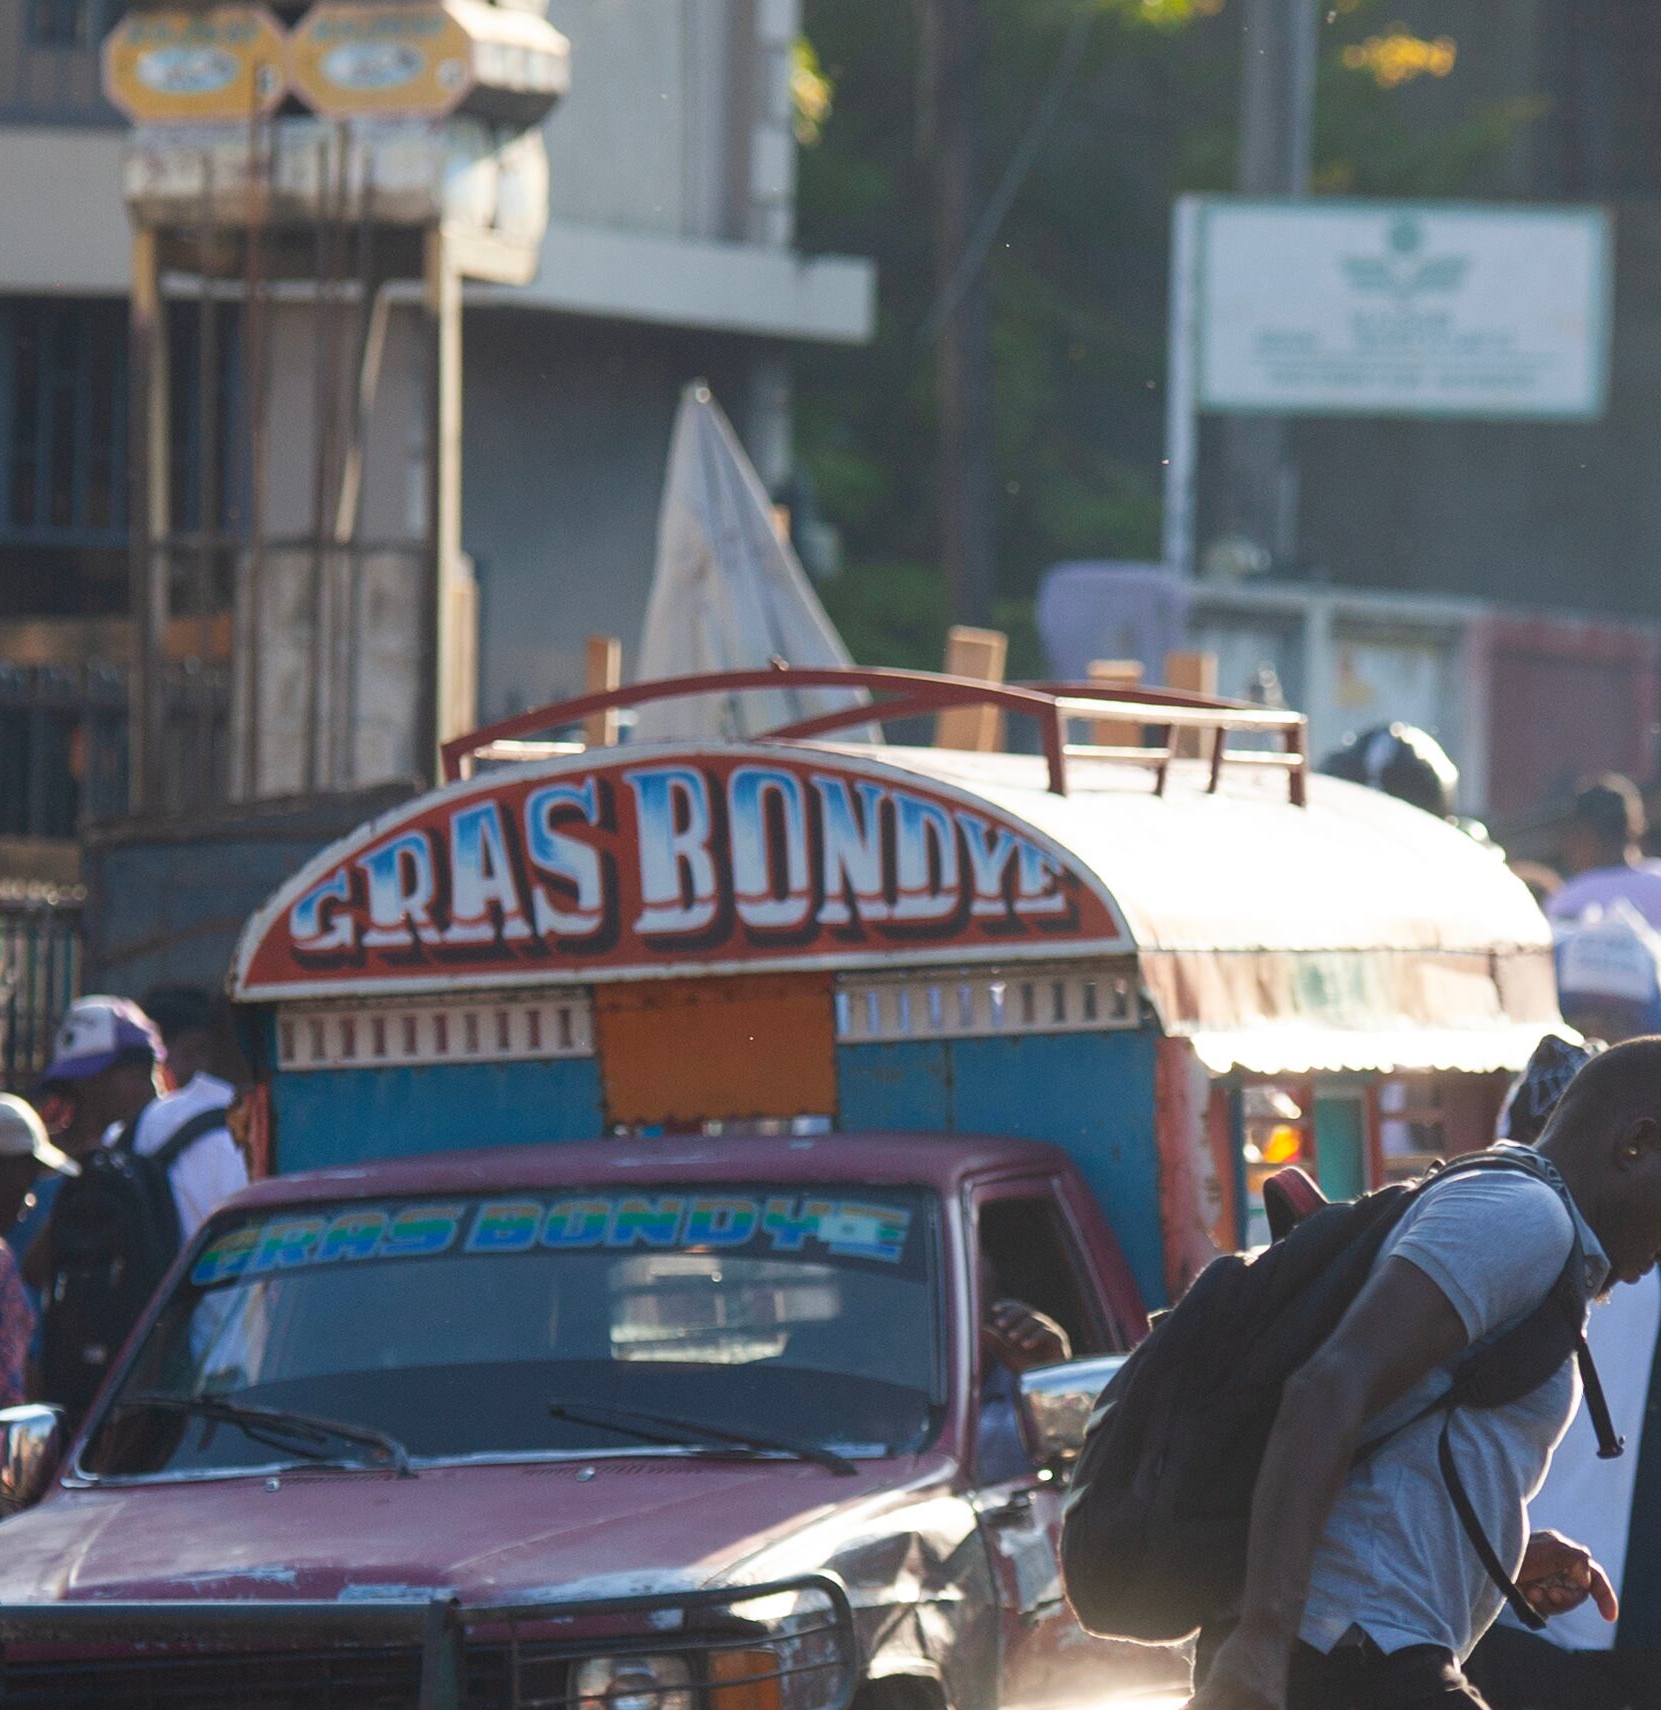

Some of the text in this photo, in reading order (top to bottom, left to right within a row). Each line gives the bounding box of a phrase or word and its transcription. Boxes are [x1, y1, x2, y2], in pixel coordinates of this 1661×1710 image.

[289, 764, 1067, 952] GRAS BONDYE
[189, 1196, 912, 1286] GRAS BONDYE
